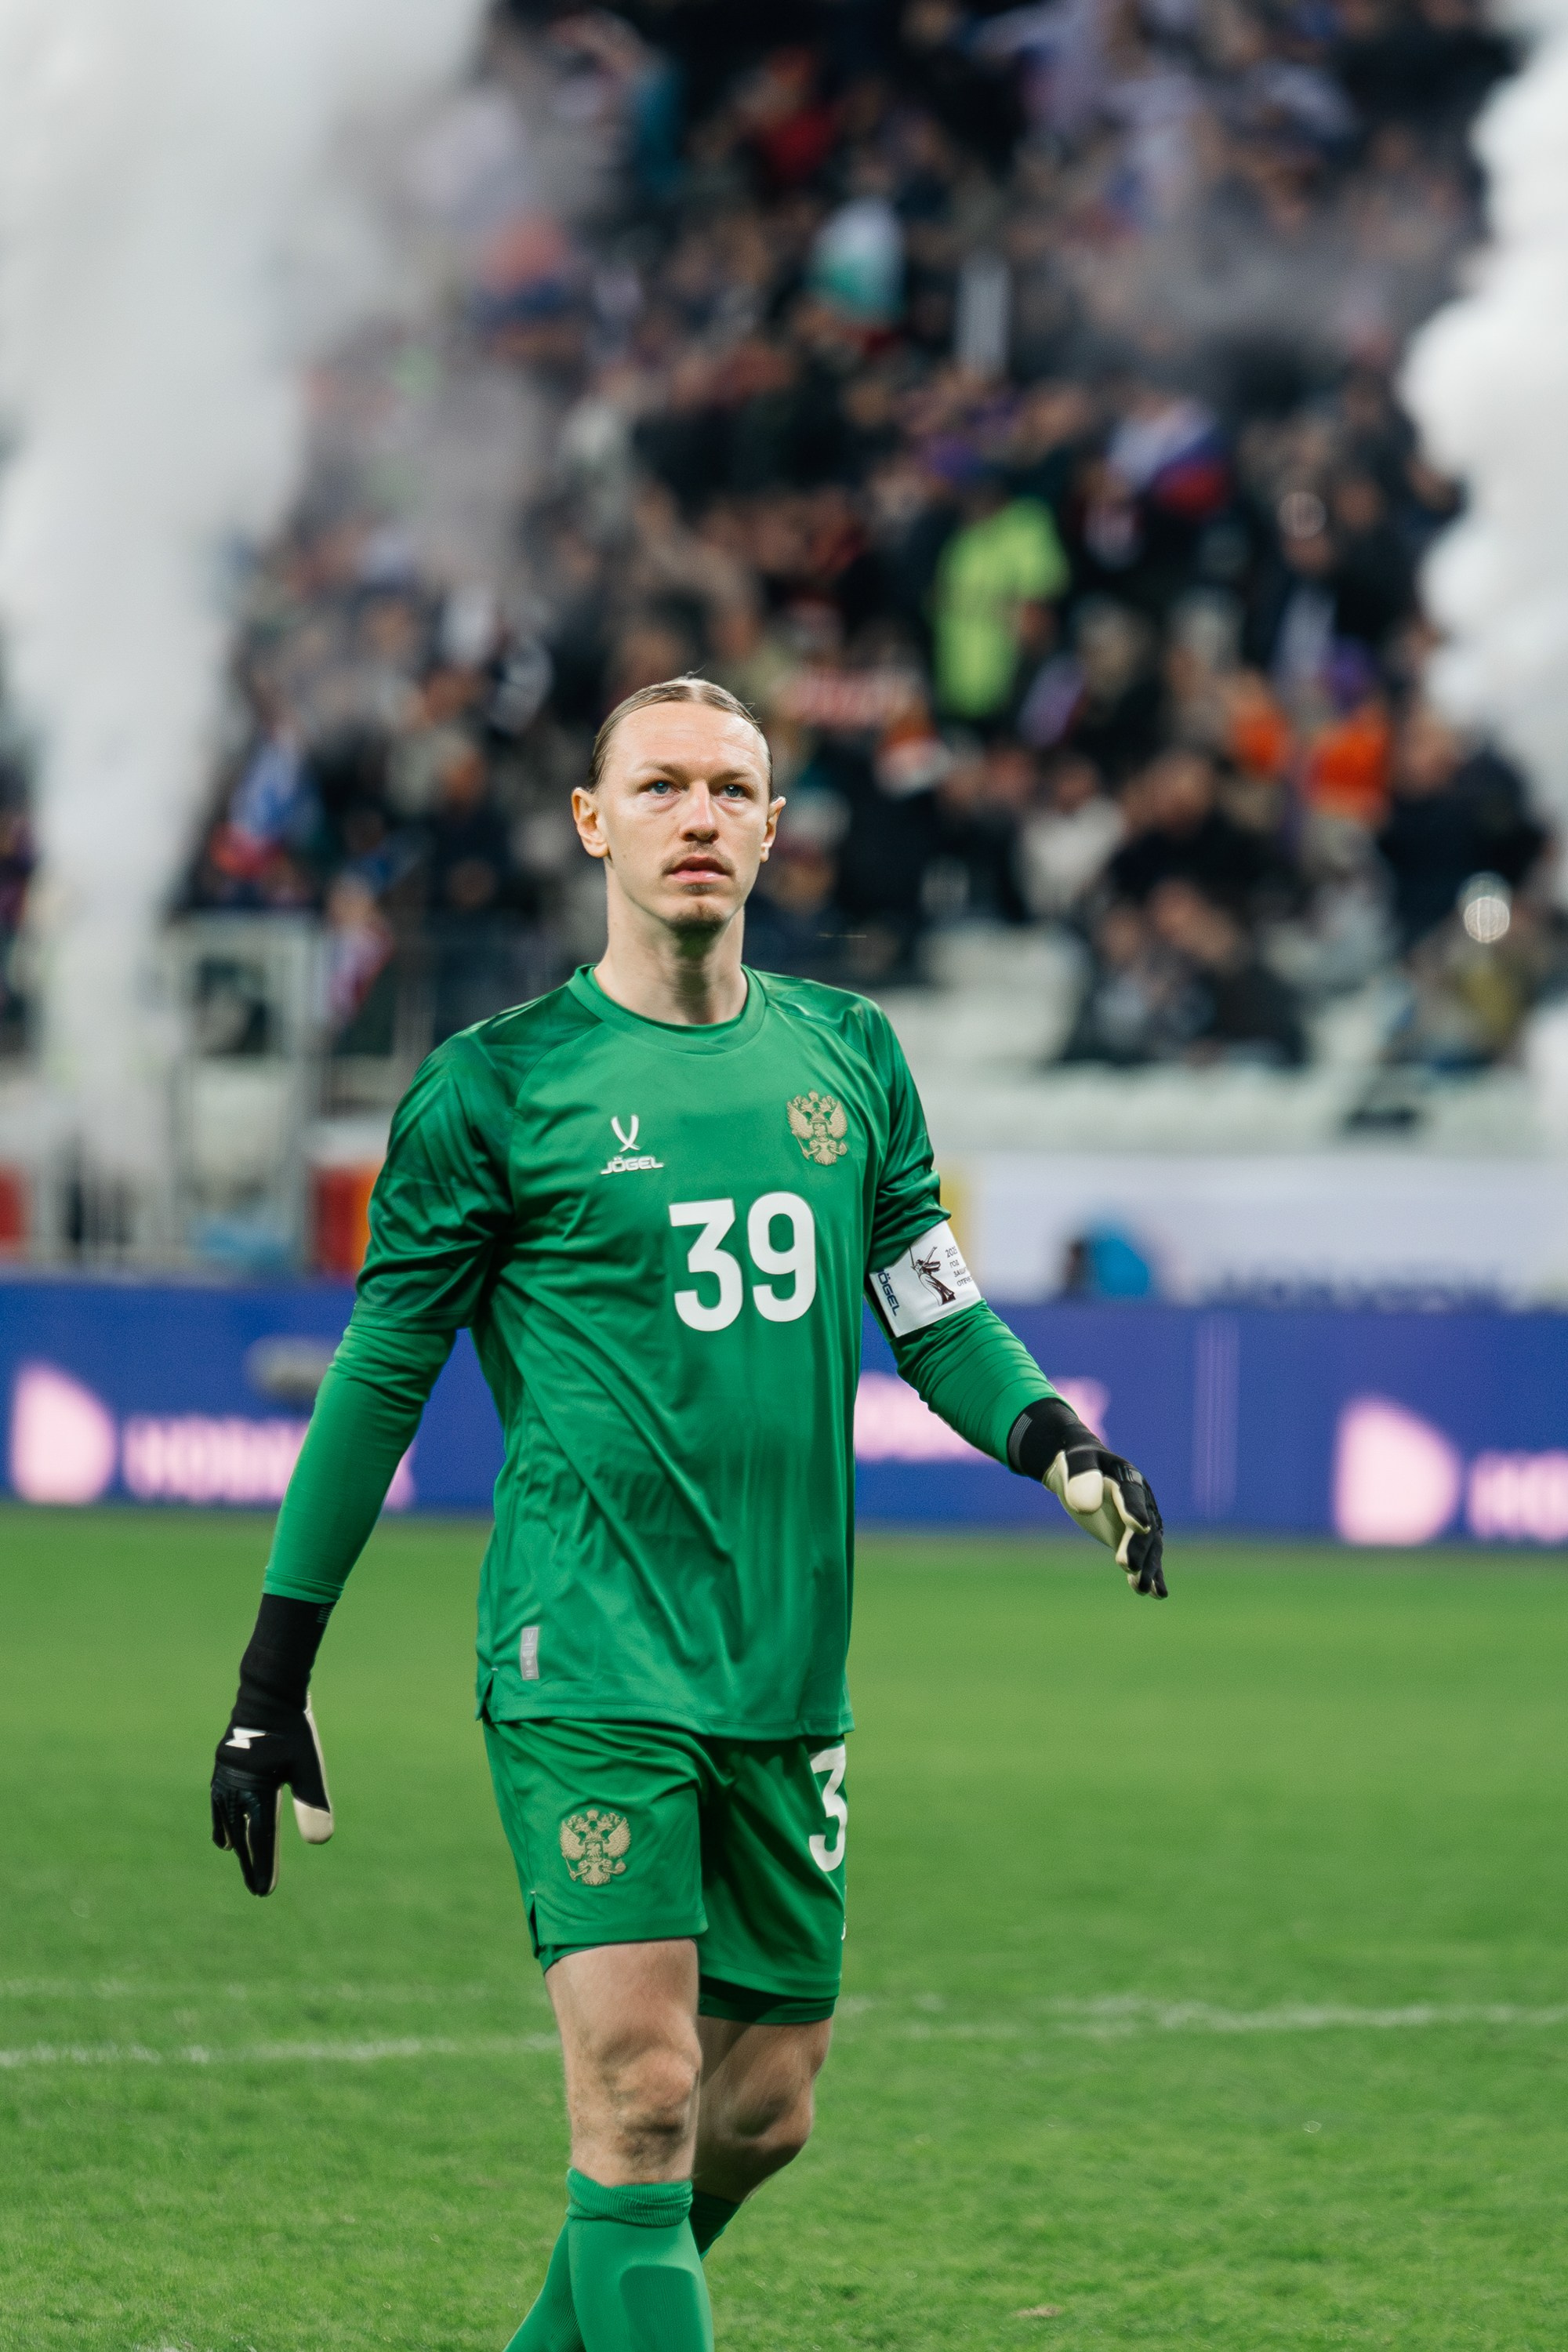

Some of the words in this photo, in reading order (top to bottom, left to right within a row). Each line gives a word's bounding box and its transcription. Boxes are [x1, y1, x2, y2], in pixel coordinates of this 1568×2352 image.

[600, 1155, 665, 1175] JÖGEL
[669, 1190, 817, 1332] 39
[809, 1744, 848, 1872] 3
